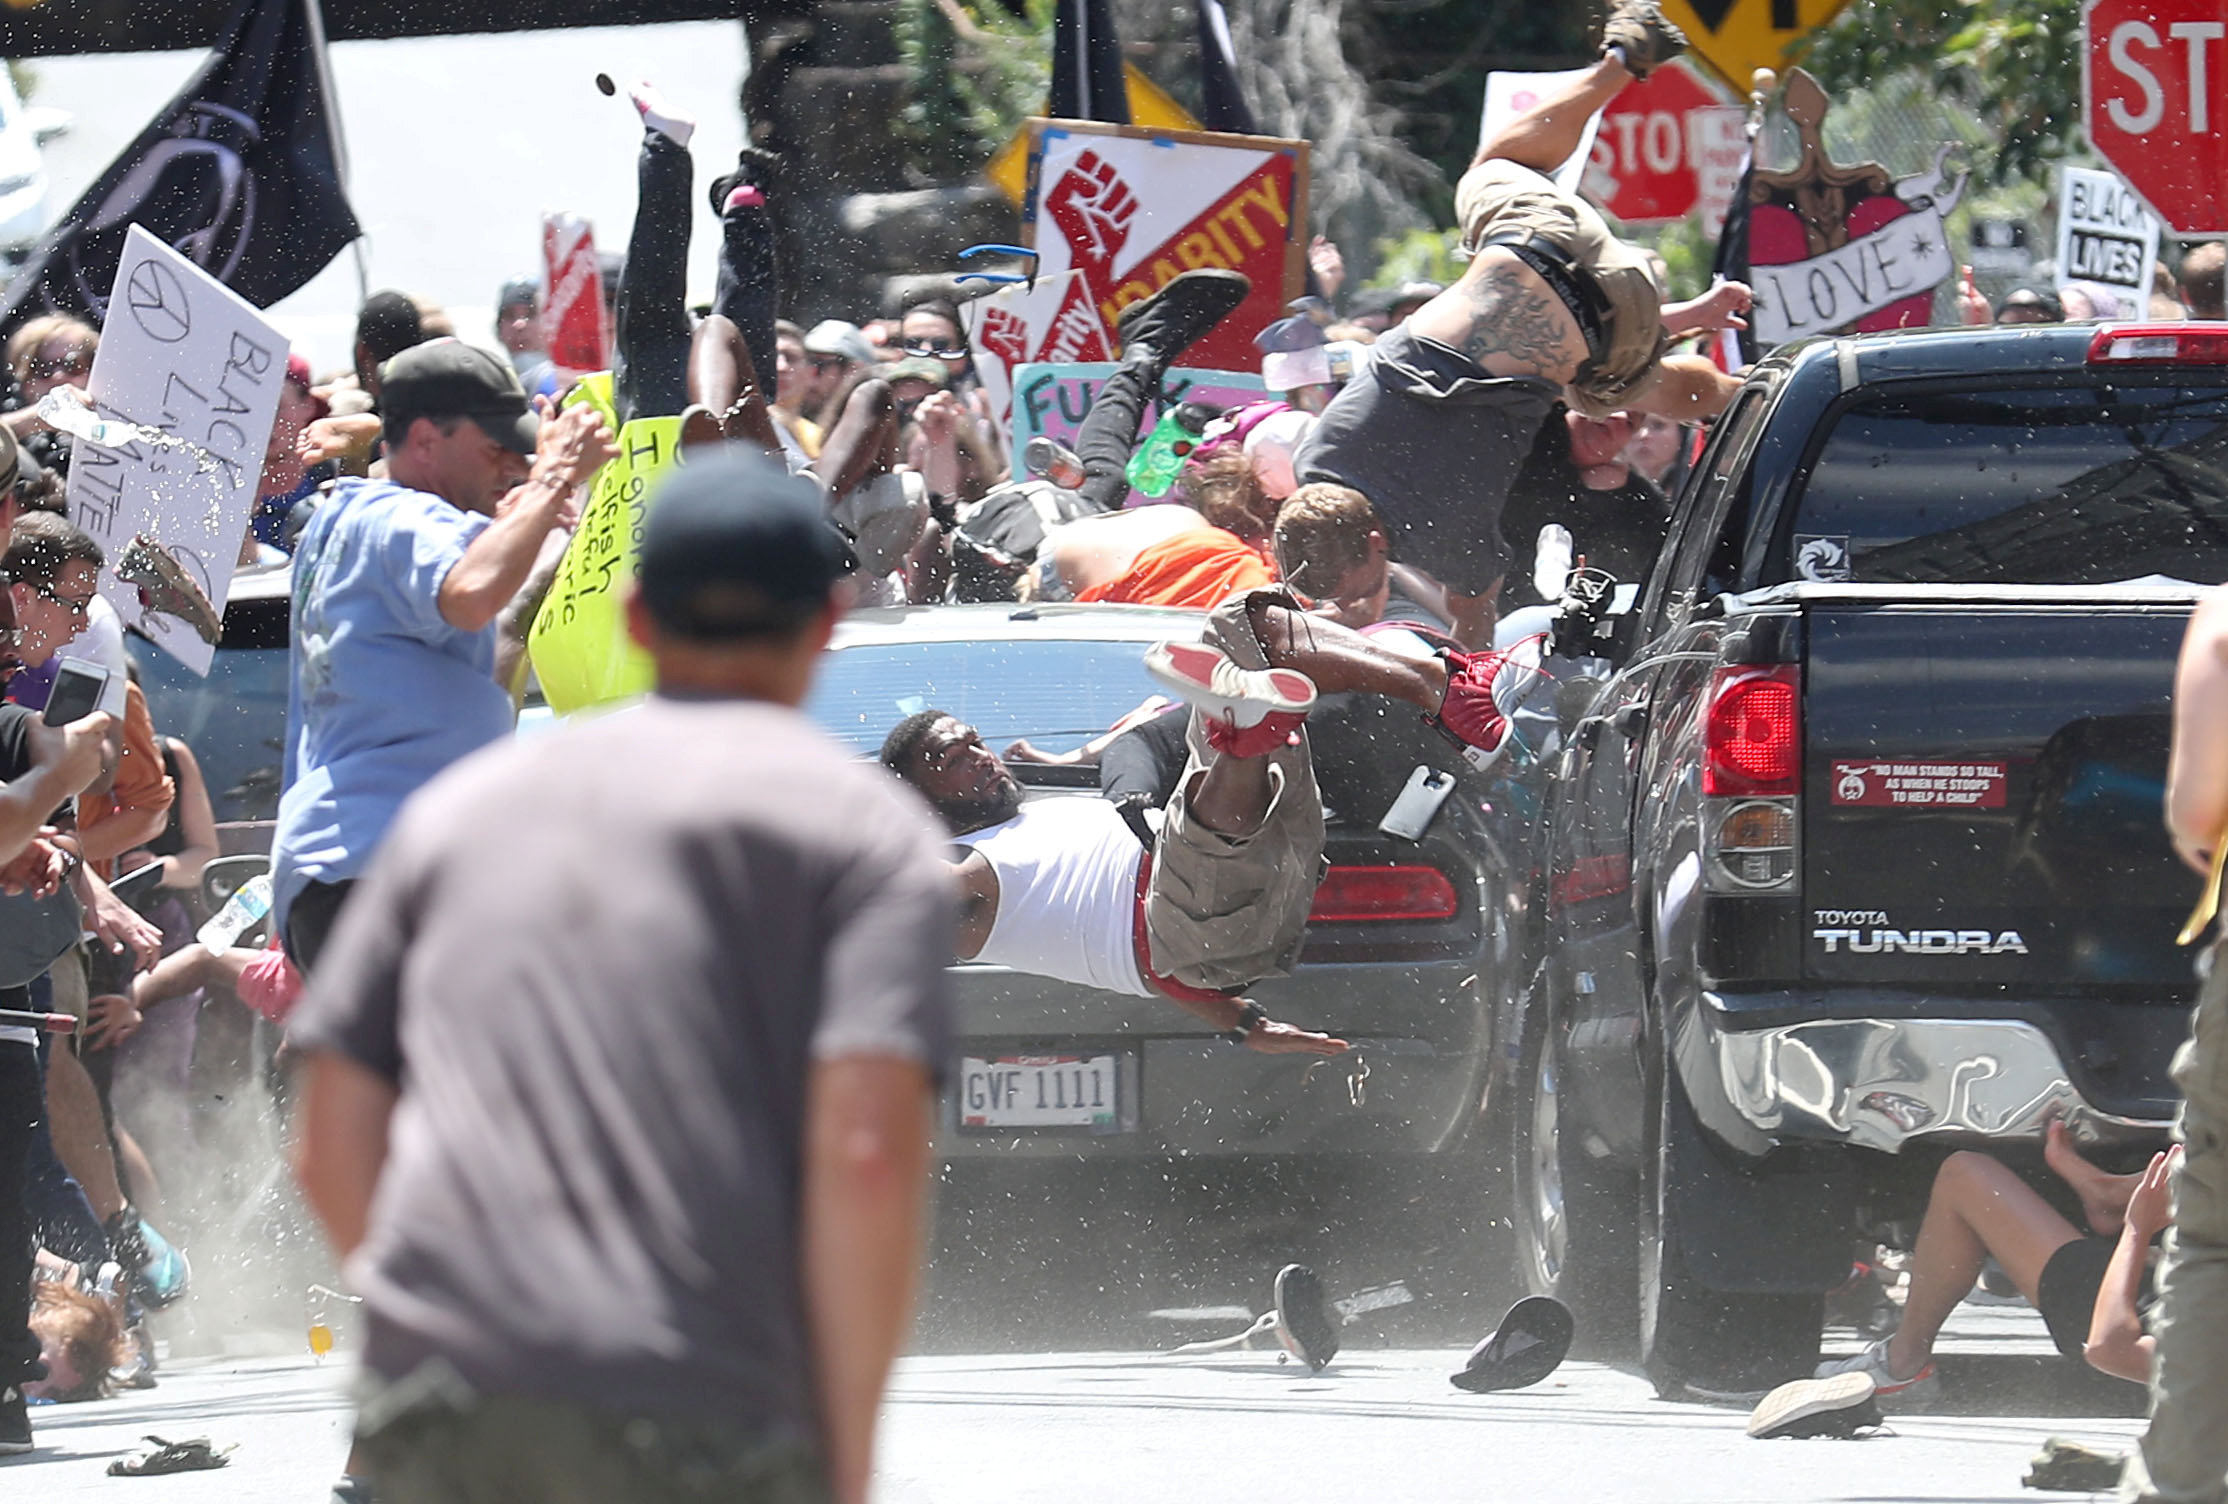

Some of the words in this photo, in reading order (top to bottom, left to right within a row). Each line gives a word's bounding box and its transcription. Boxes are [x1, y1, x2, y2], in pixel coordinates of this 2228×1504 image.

[1588, 111, 1702, 175] STO
[1768, 231, 1915, 328] LOVE
[2068, 233, 2142, 284] LIVES
[194, 330, 272, 491] BLACK
[1813, 929, 2029, 954] TUNDRA
[1814, 910, 1889, 925] TOYOTA
[968, 1070, 1022, 1110] GVF
[1034, 1068, 1105, 1109] 1111
